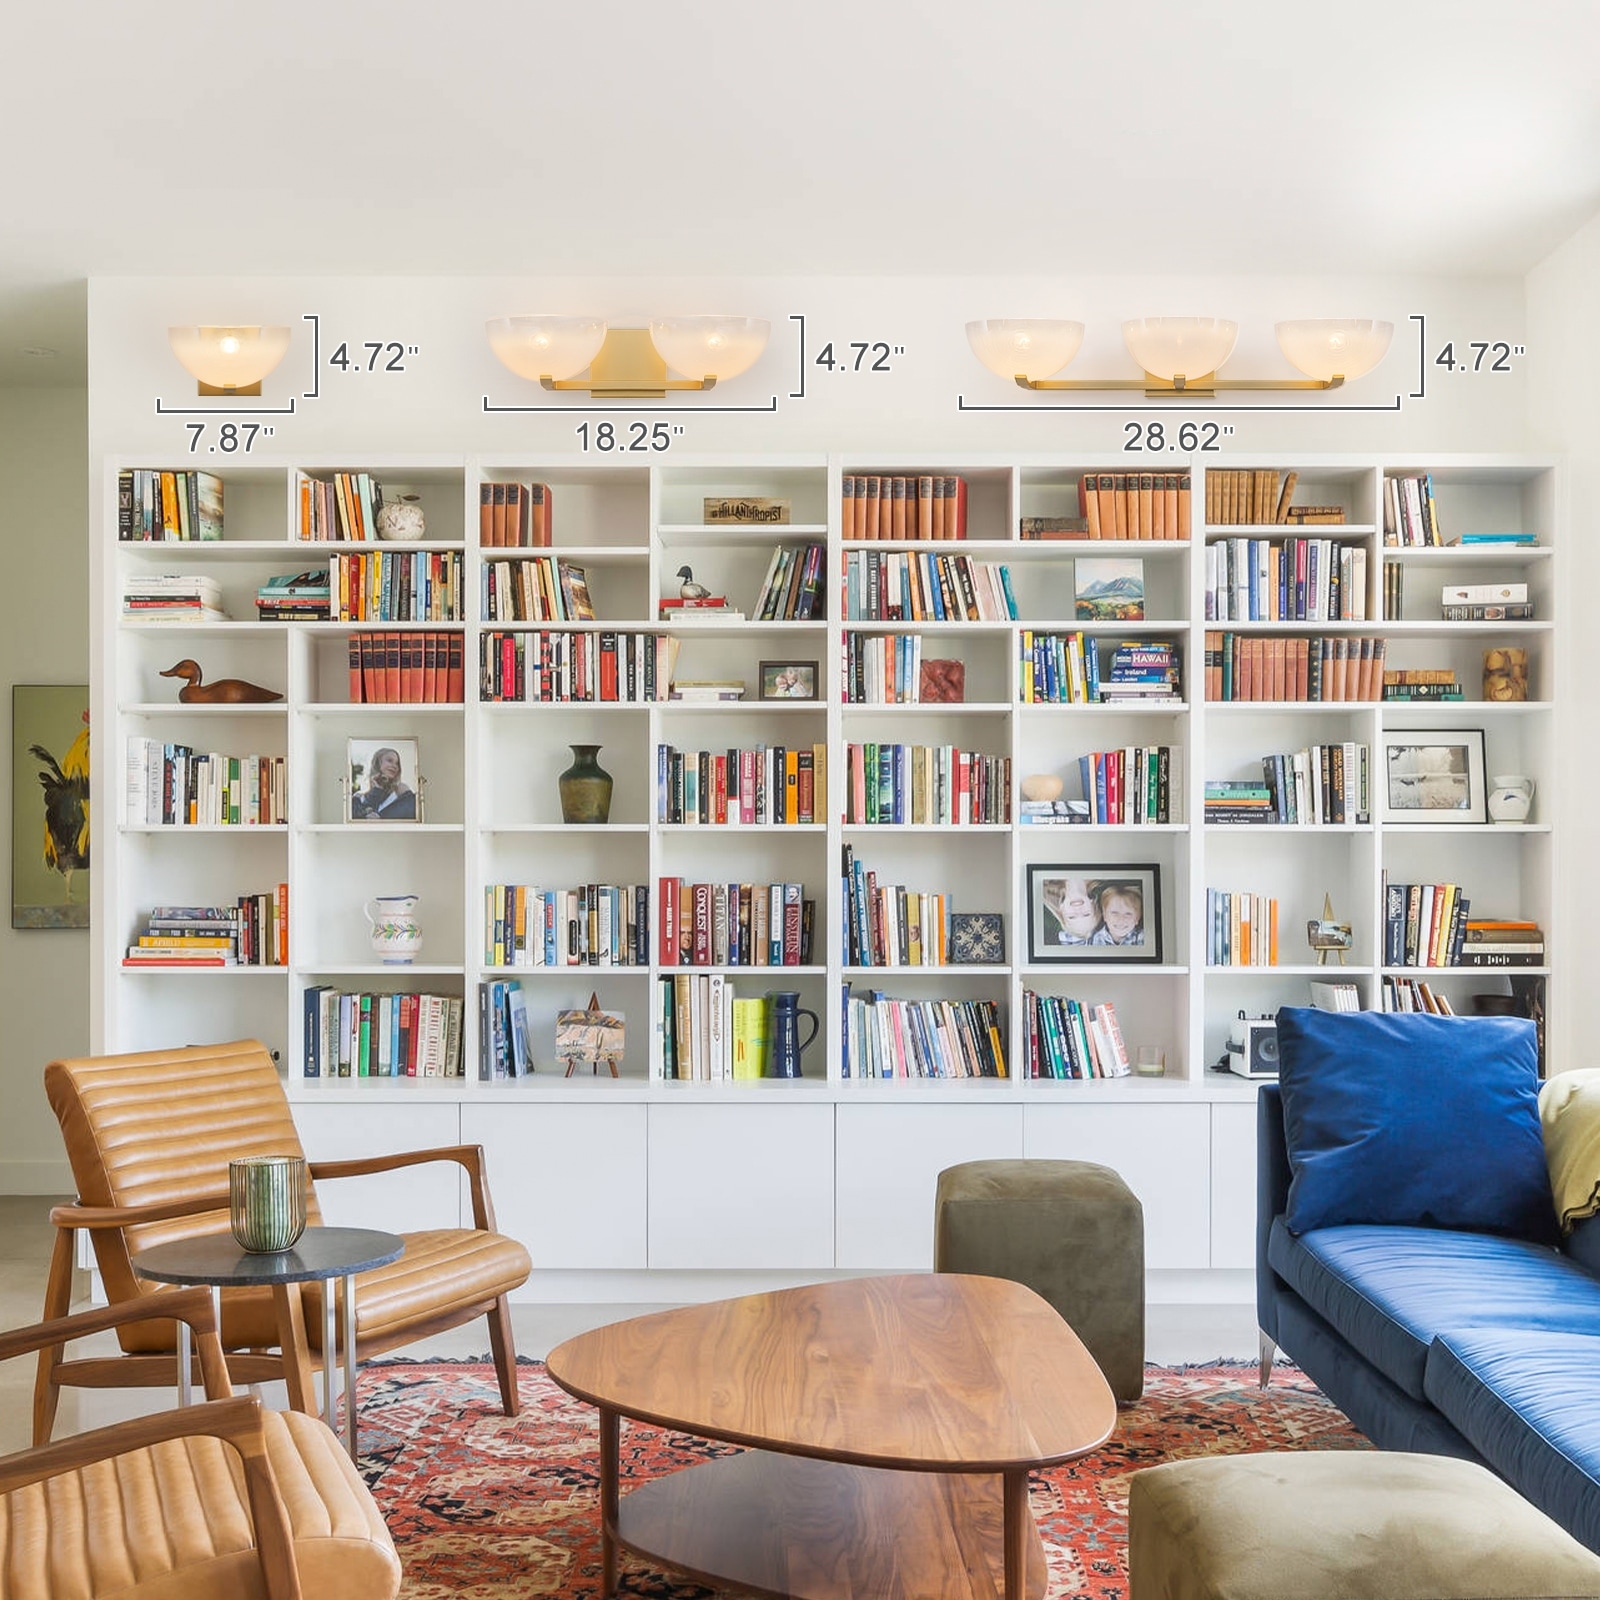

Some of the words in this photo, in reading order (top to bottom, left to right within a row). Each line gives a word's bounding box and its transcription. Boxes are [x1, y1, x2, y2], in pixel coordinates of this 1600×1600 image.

[1132, 653, 1169, 664] HAWAII
[696, 888, 708, 932] CONQUEST
[715, 895, 725, 930] TITAN
[790, 907, 799, 953] EINSTEIN
